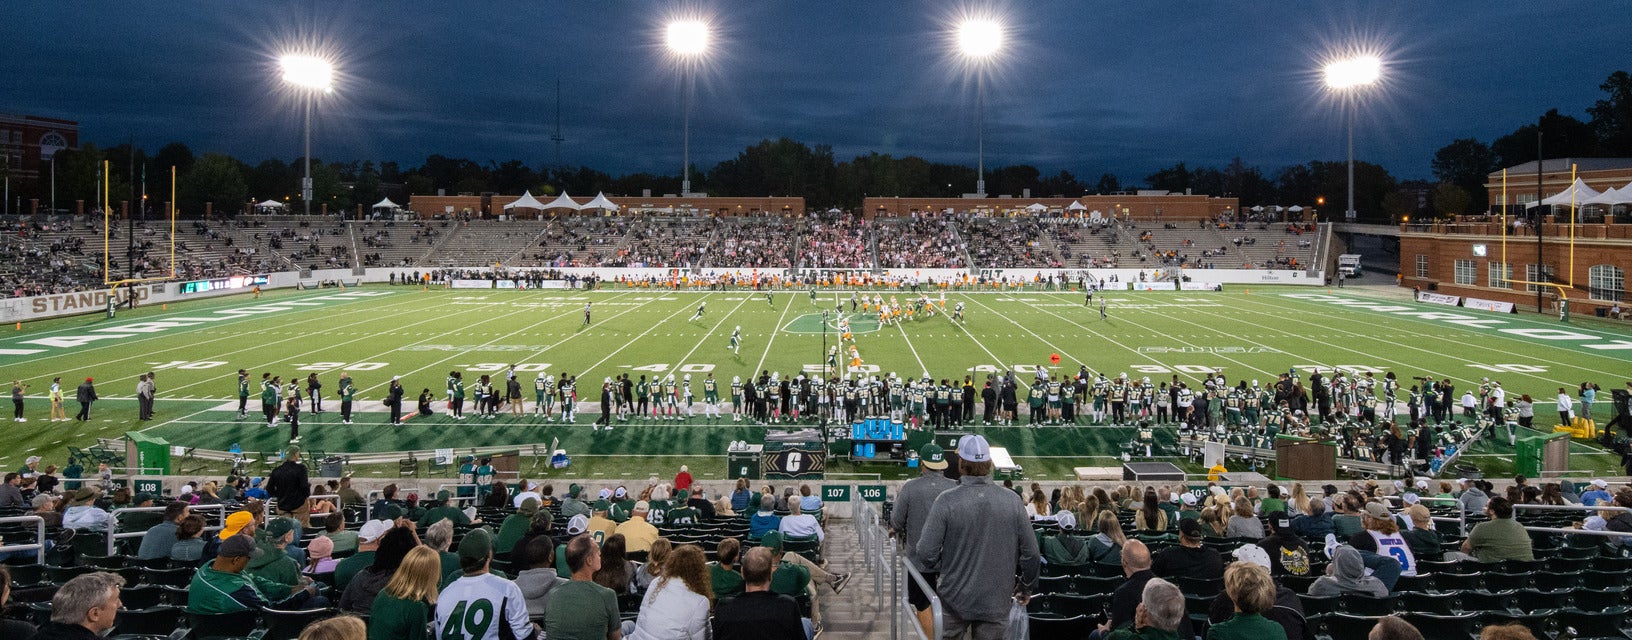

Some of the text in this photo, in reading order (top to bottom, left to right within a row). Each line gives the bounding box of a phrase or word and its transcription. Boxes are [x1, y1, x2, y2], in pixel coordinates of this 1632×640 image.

[1070, 217, 1109, 225] NATION
[154, 360, 229, 370] 10
[296, 361, 390, 371] 20
[465, 362, 553, 372] 30
[631, 363, 716, 373] 40
[1129, 364, 1218, 374] 30
[140, 483, 157, 492] 108
[827, 488, 844, 498] 107
[863, 488, 881, 498] 106
[440, 598, 494, 640] 49
